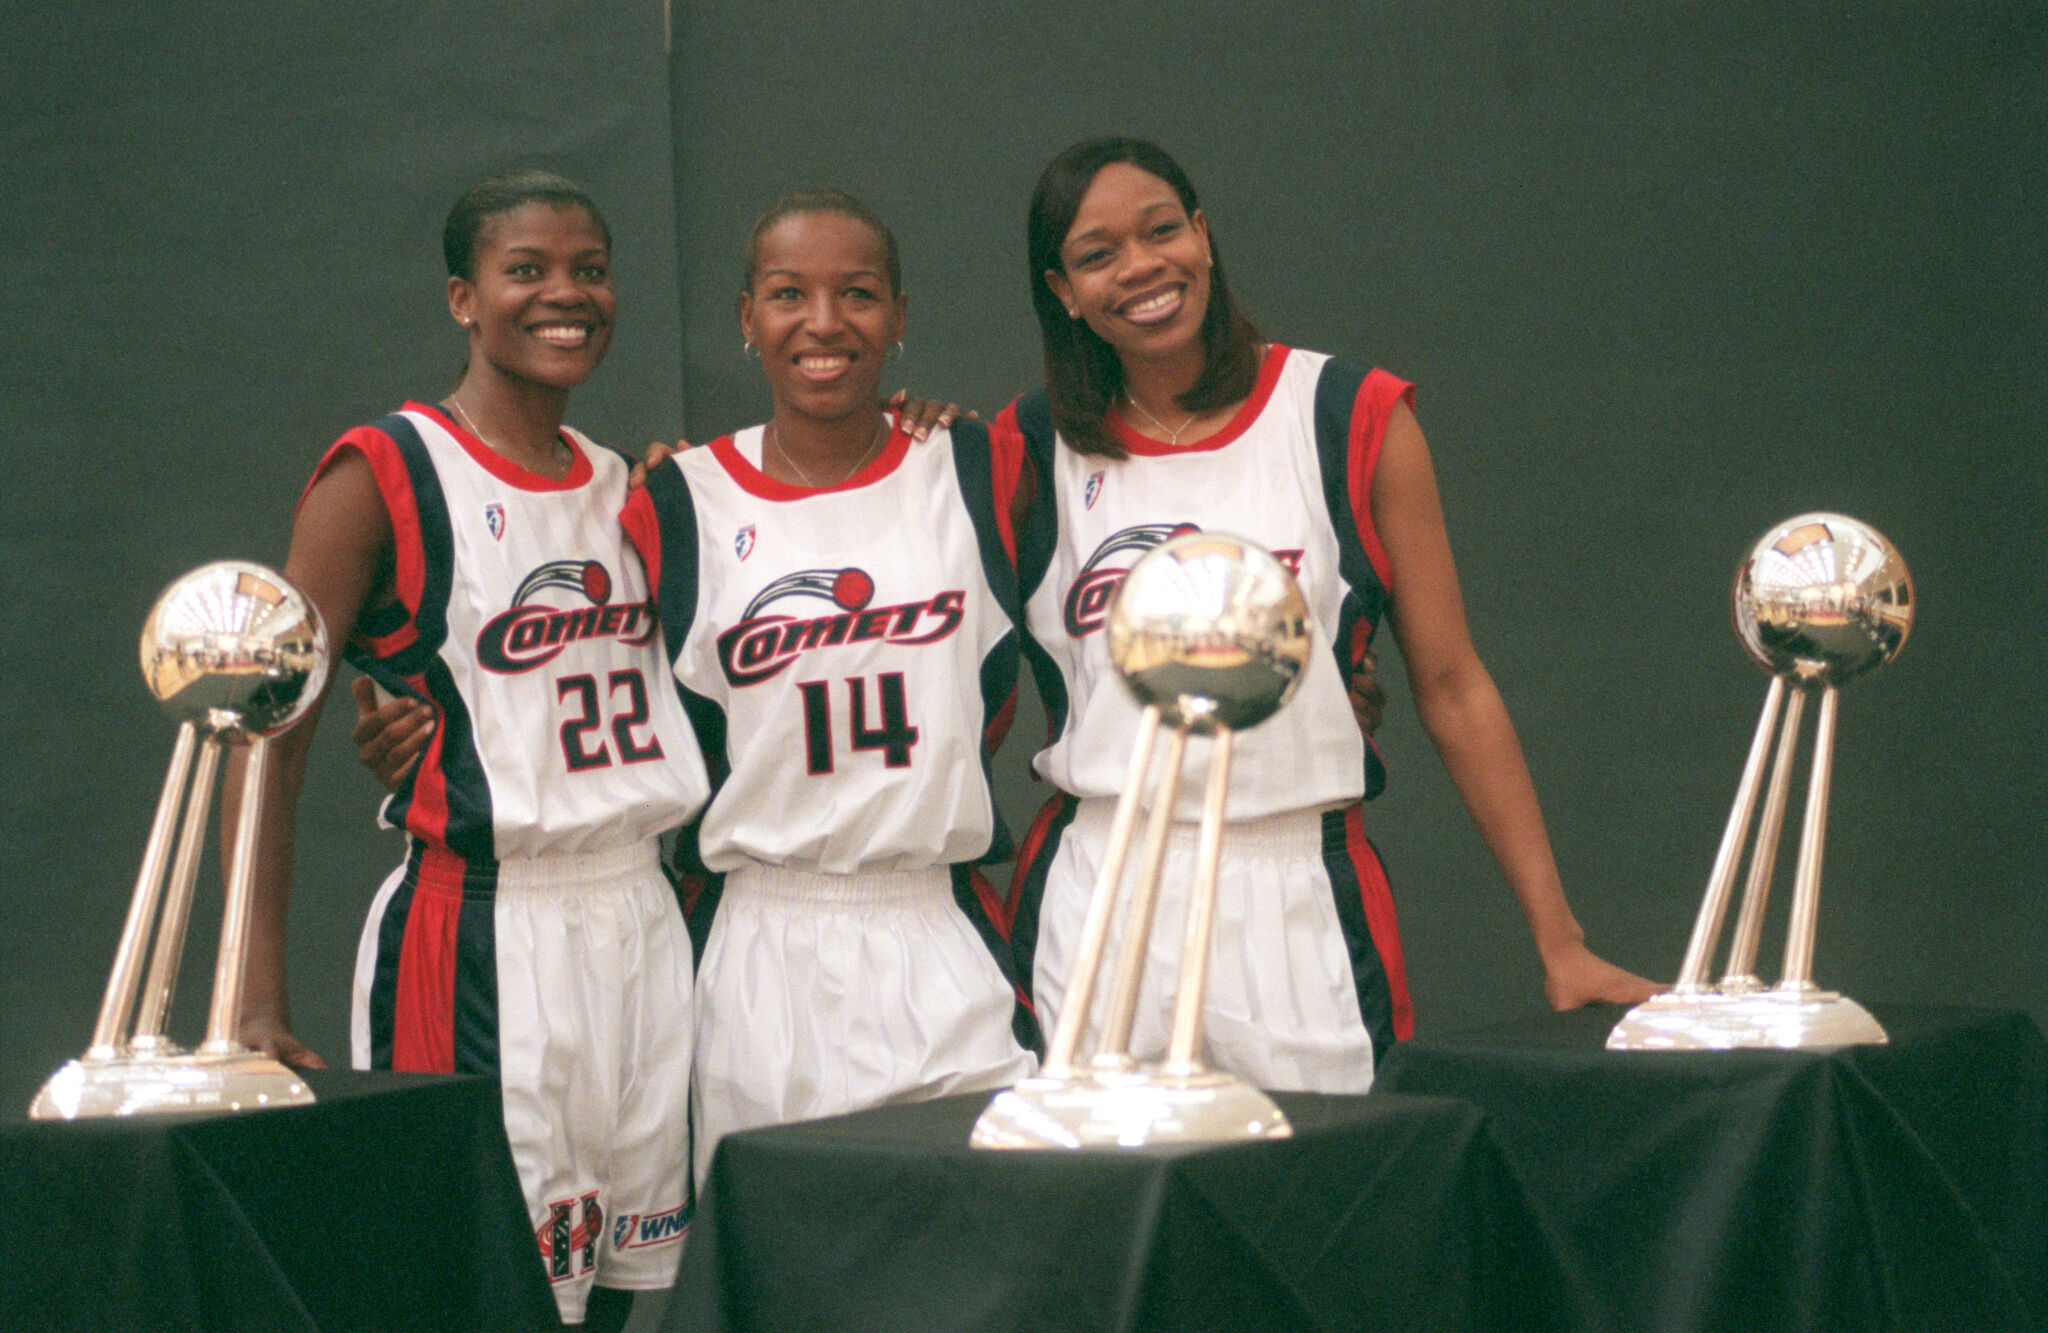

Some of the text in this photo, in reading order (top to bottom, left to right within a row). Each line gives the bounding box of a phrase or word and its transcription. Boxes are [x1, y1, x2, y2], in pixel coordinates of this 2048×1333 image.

[716, 590, 966, 688] COMETS
[556, 667, 665, 773] 22
[795, 671, 919, 776] 14
[641, 1206, 689, 1241] WNB
